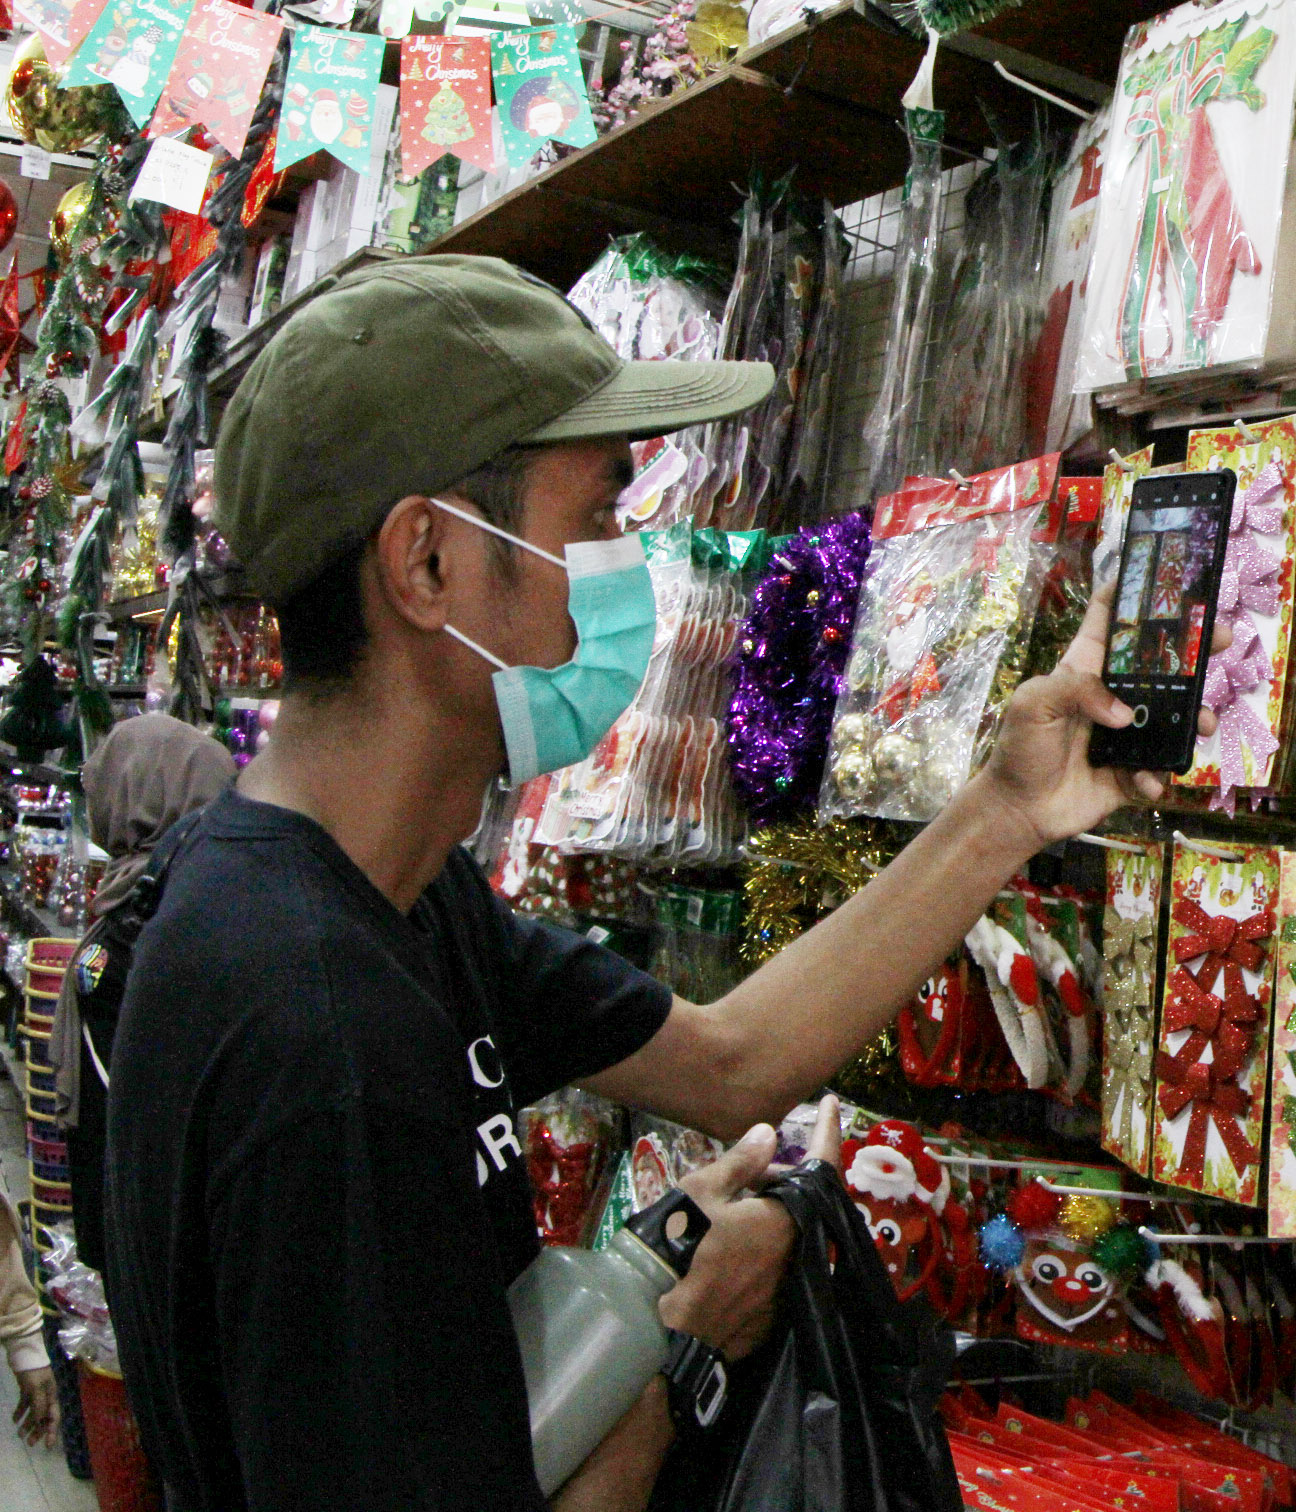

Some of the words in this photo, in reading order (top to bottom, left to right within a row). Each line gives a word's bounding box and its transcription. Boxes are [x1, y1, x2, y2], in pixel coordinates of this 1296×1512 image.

[208, 31, 261, 60] Christmas
[302, 26, 338, 57] Merry
[408, 36, 445, 63] Merry
[498, 31, 530, 55] Merry
[313, 58, 367, 79] Christmas
[425, 64, 478, 81] Christmas
[516, 55, 568, 74] Christmas
